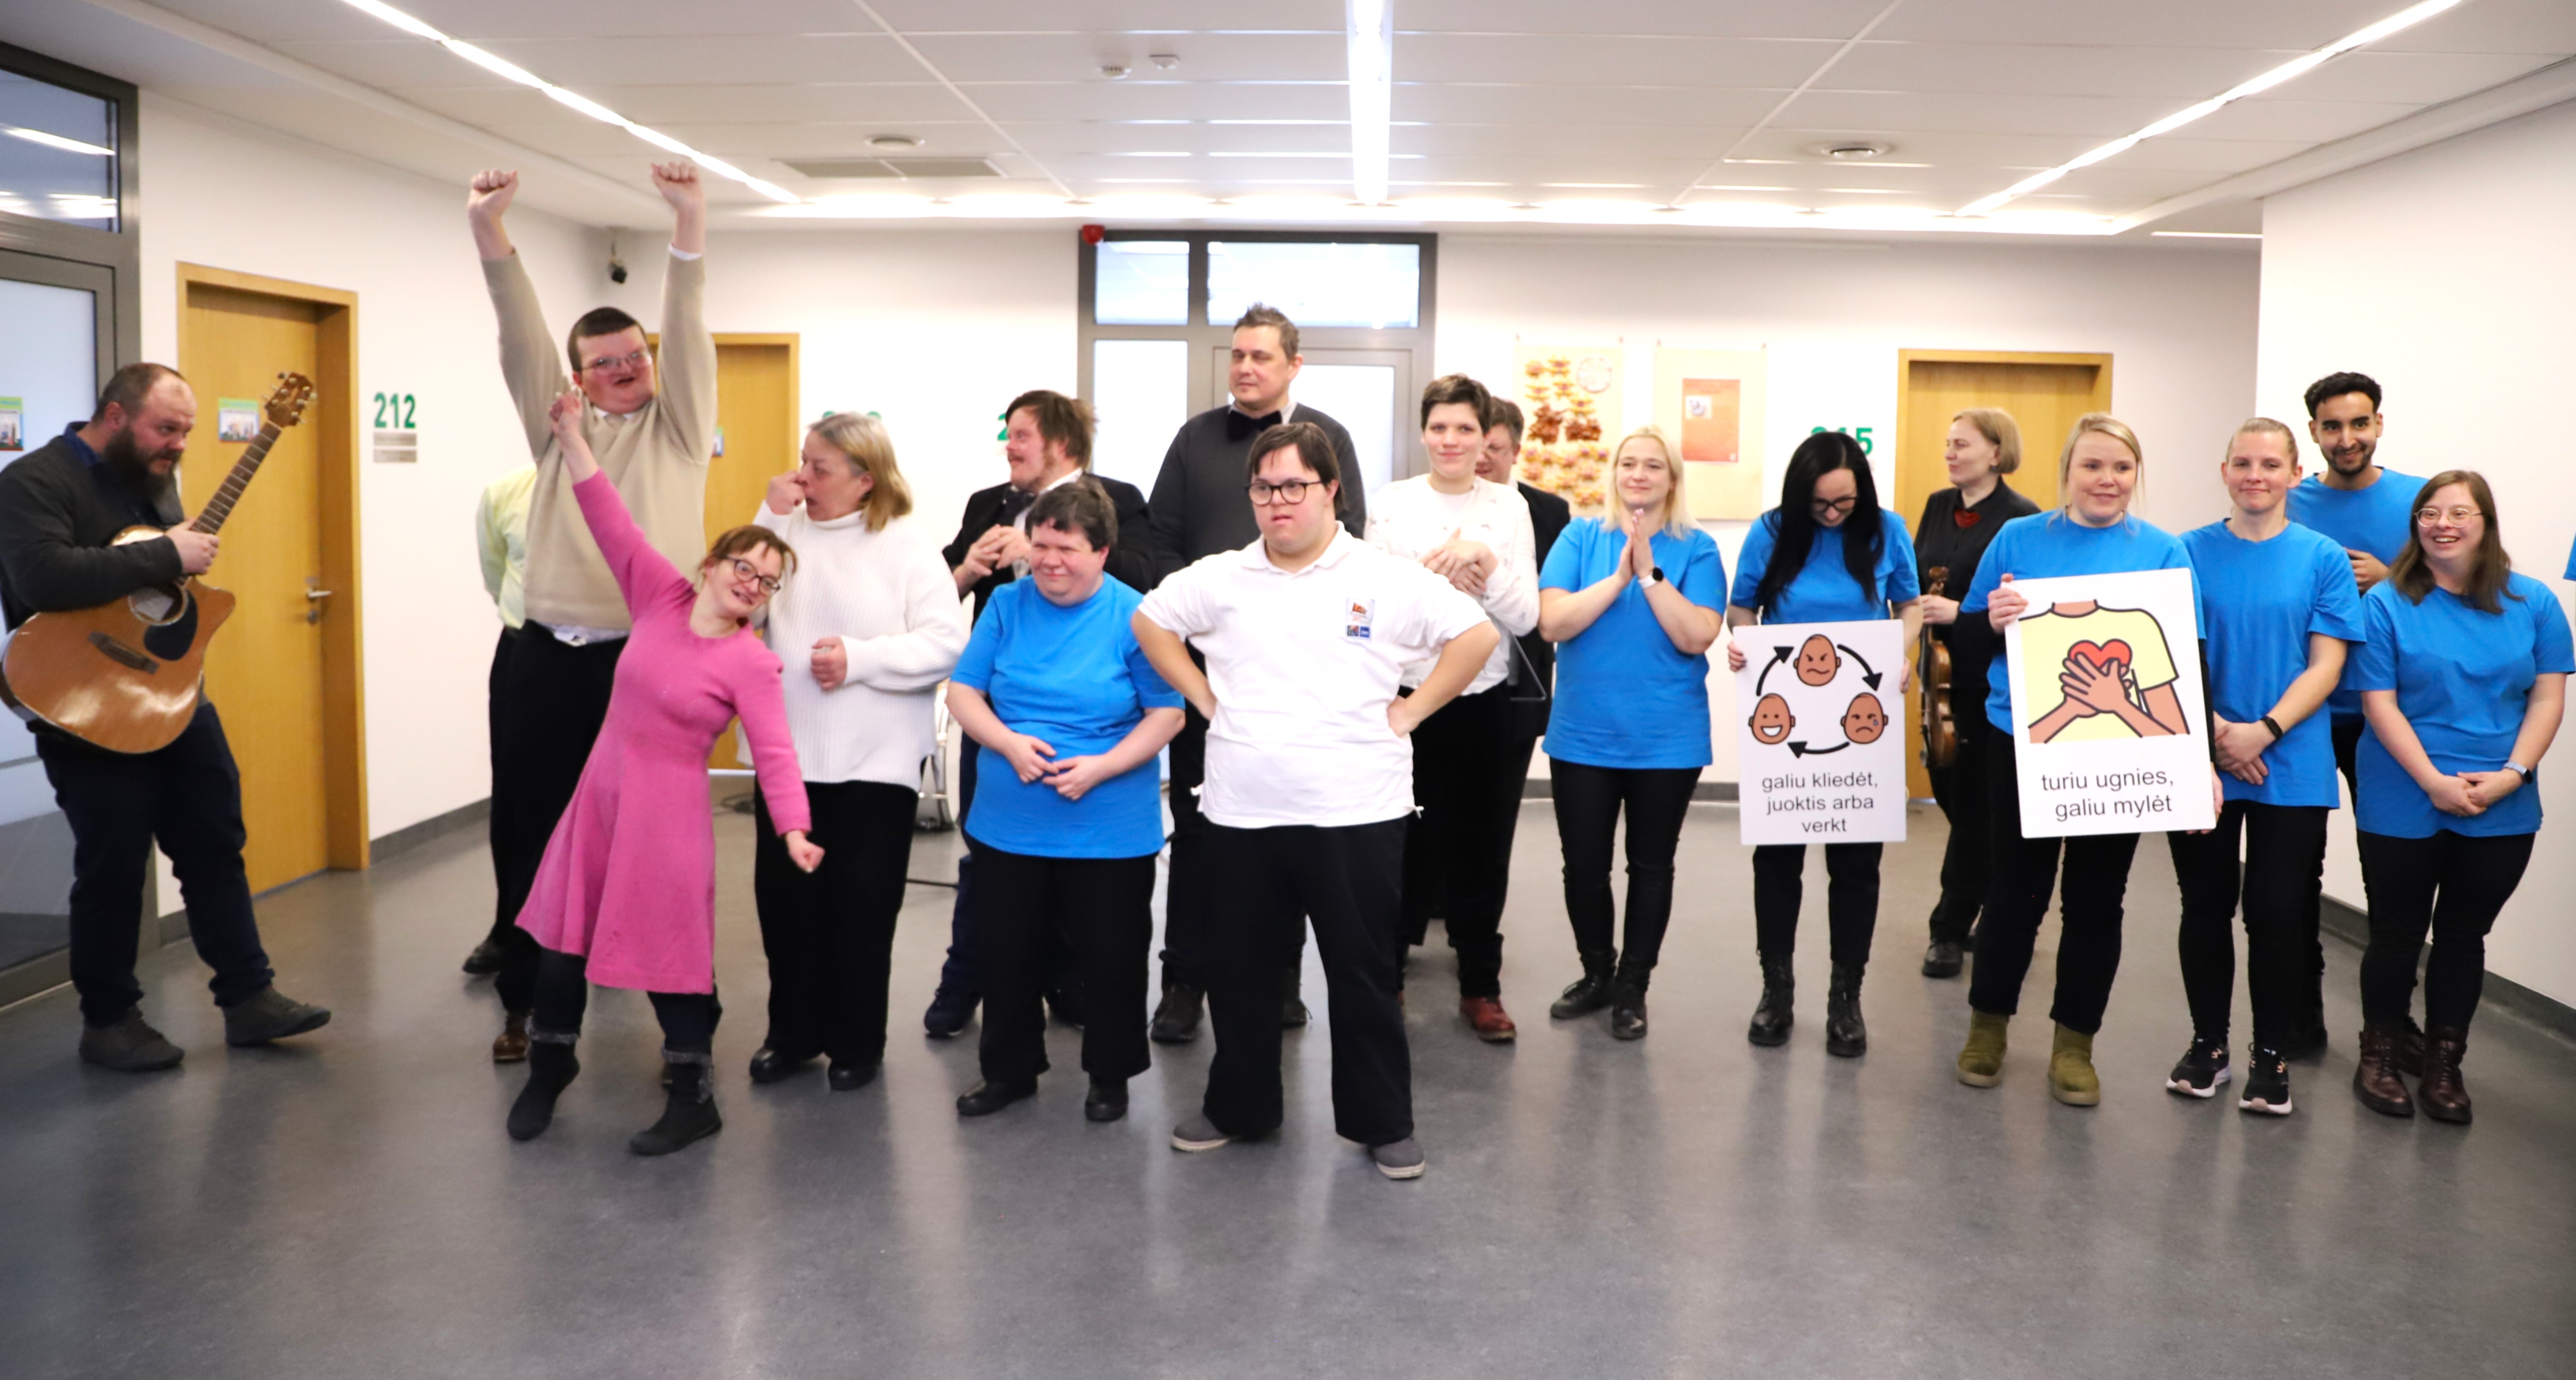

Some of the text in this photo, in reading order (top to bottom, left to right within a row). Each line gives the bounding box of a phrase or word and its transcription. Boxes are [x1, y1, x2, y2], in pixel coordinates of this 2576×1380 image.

[373, 392, 416, 429] 212
[1762, 771, 1878, 793] galiu kliedėt,
[2041, 768, 2174, 792] turiu ugnies,
[1766, 794, 1874, 815] juoktis arba
[2055, 795, 2172, 822] galiu mylėt
[1802, 817, 1847, 833] verkt
